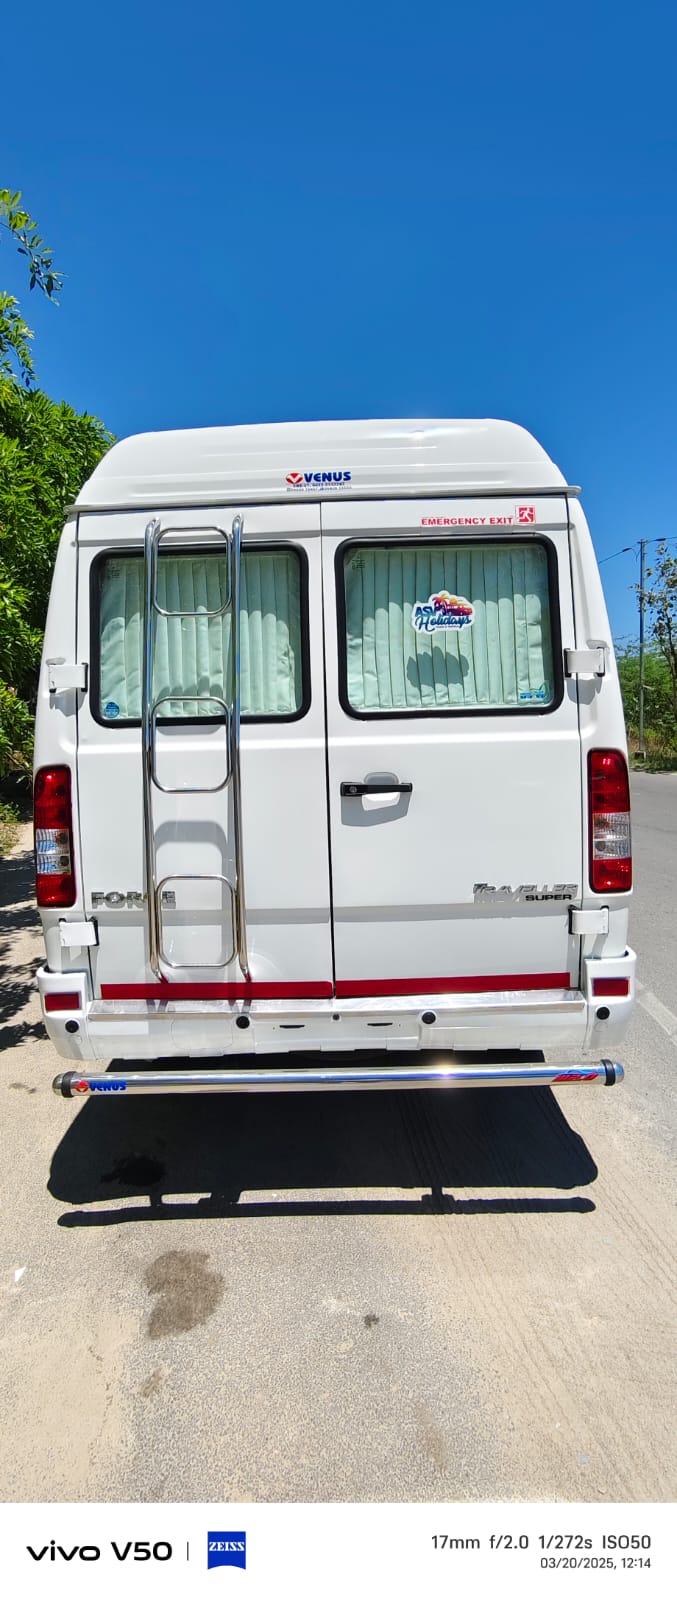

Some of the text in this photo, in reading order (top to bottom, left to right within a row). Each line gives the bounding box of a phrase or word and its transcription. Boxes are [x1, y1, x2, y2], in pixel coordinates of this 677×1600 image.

[304, 472, 351, 482] VENUS
[421, 517, 486, 525] EMERGENCY
[415, 614, 472, 632] Holidays
[91, 891, 175, 905] FORE
[89, 1080, 127, 1091] VENUS
